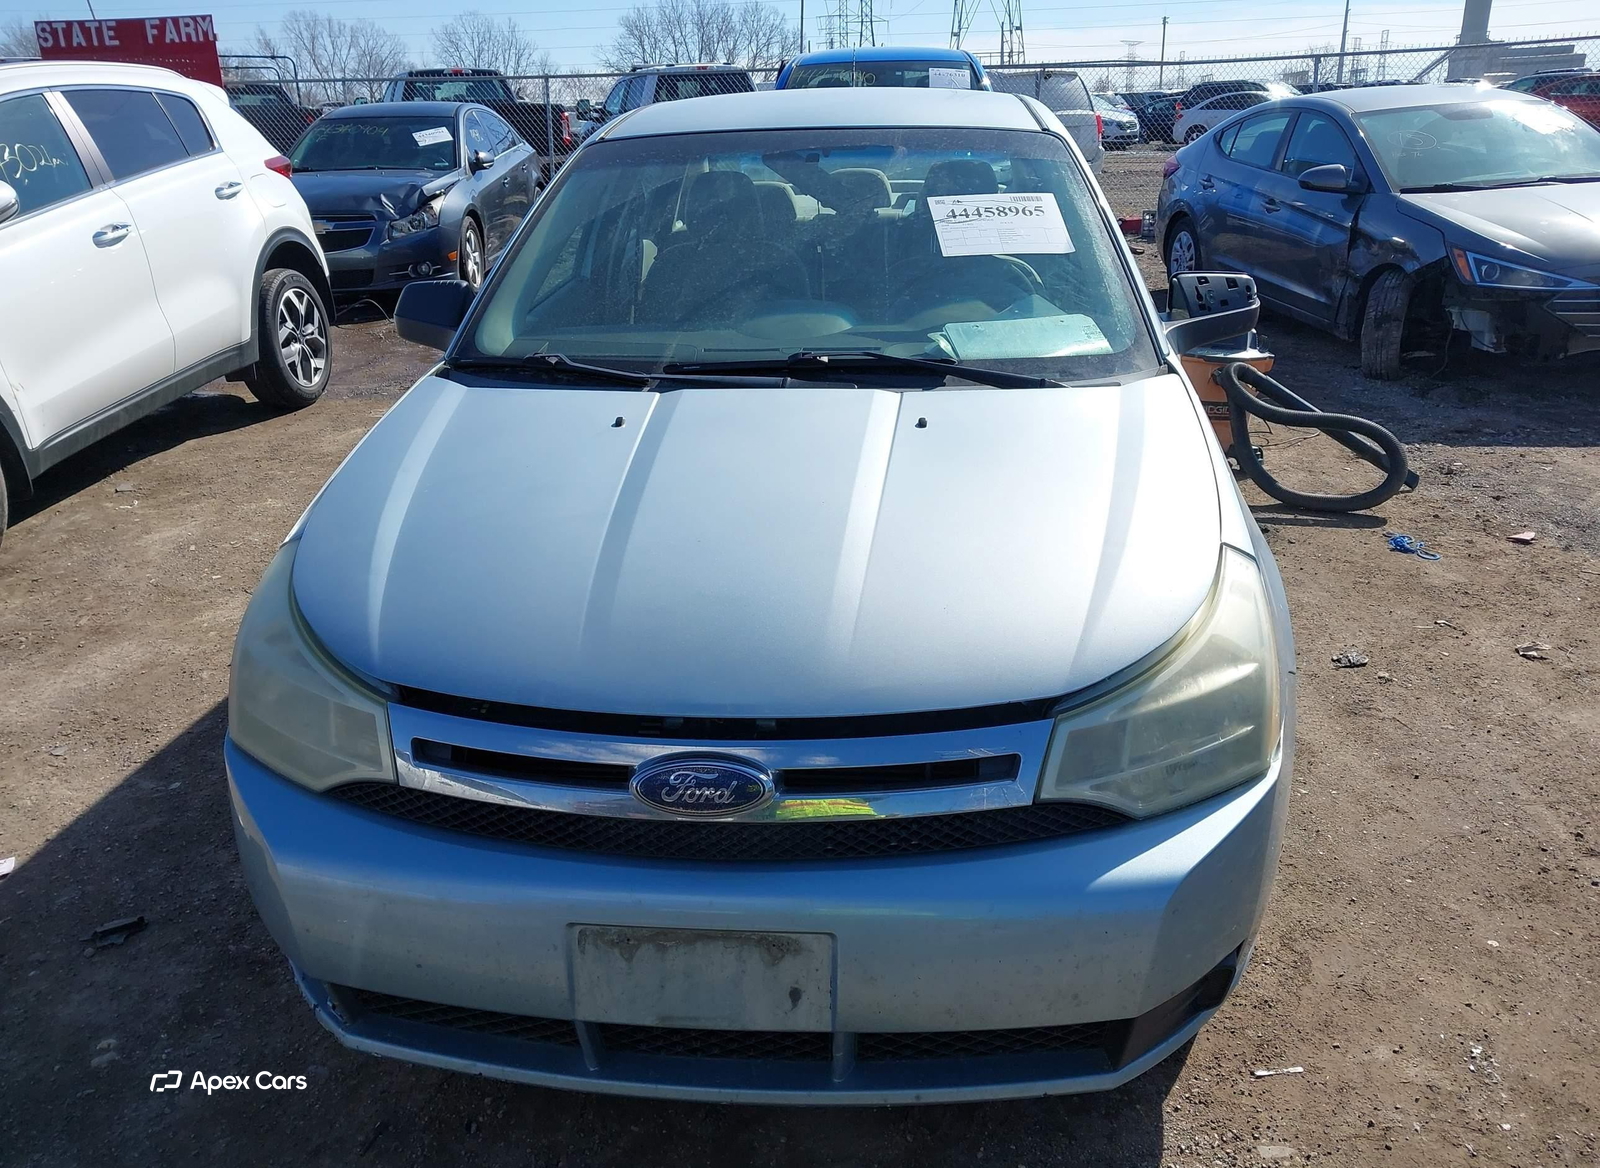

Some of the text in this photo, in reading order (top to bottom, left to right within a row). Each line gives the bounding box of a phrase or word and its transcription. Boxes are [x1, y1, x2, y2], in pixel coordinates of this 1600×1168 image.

[36, 16, 214, 48] STATE FARM
[945, 204, 1045, 219] 44458965
[1205, 405, 1230, 415] IDGI
[661, 770, 738, 805] Ford
